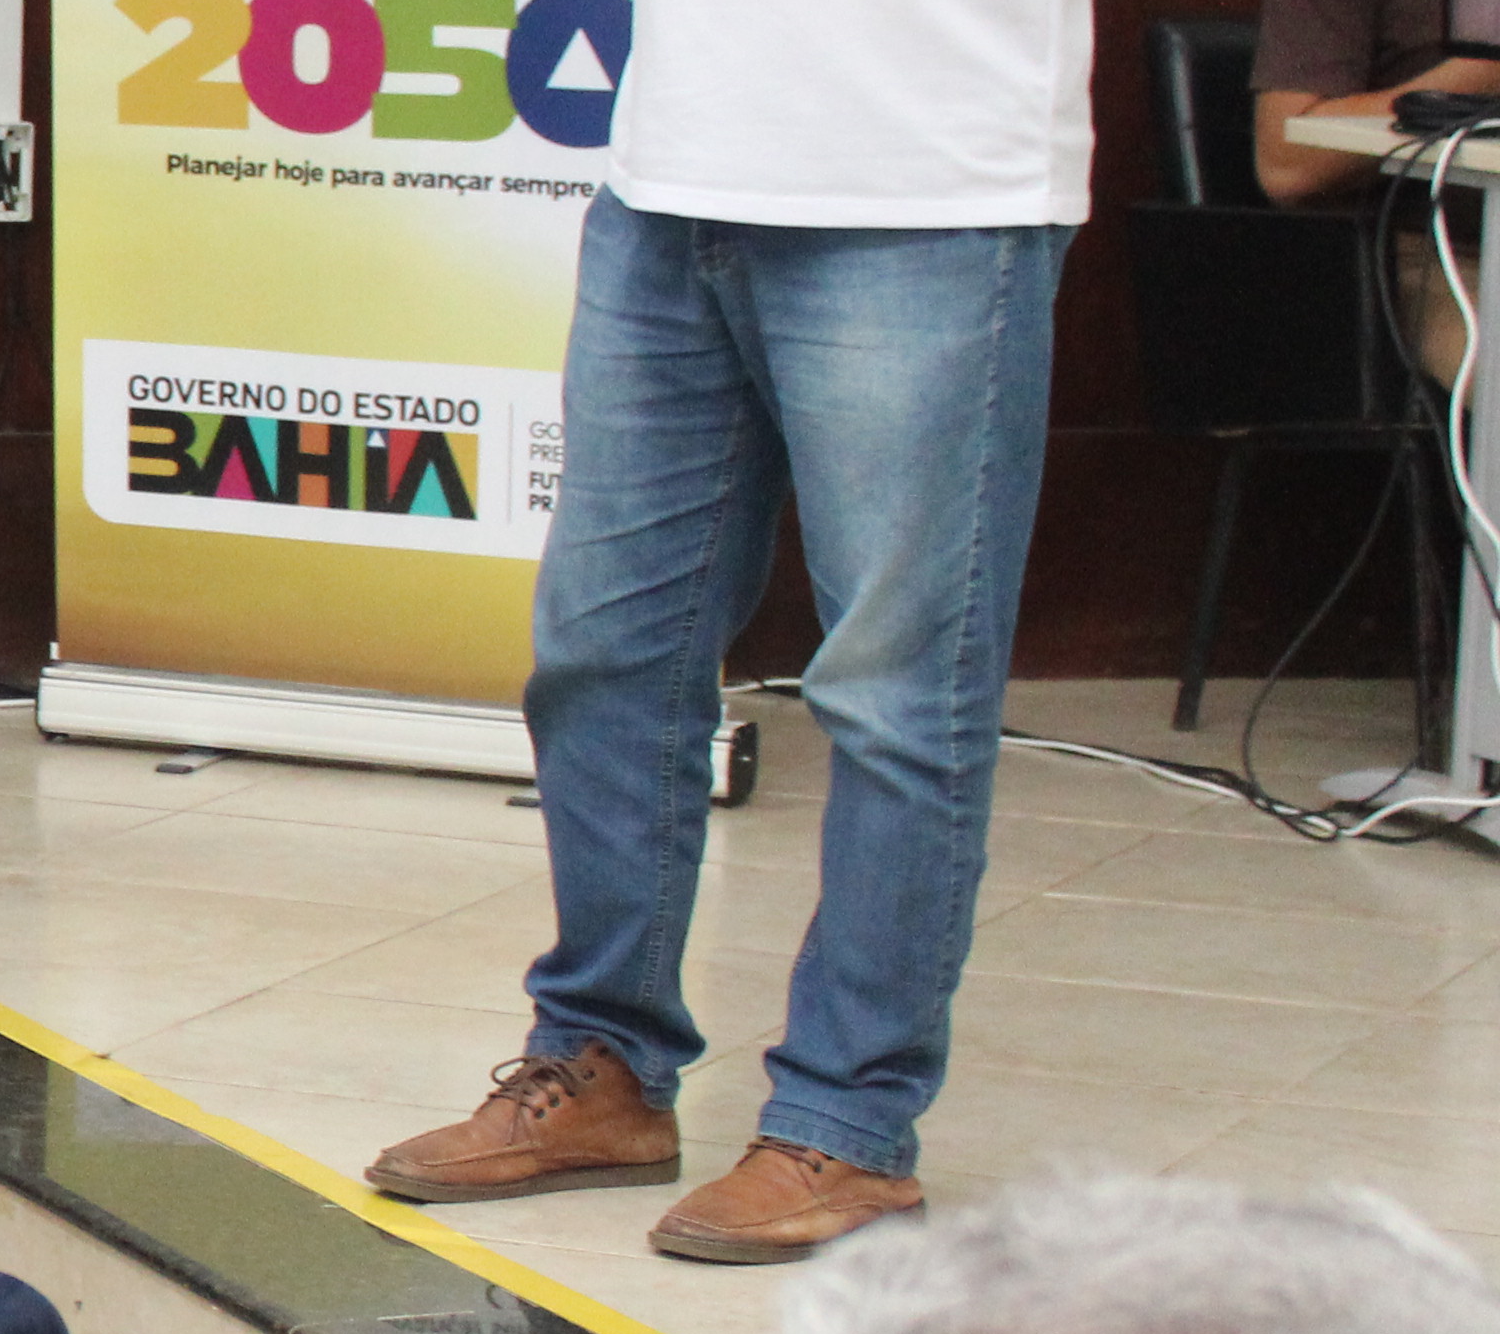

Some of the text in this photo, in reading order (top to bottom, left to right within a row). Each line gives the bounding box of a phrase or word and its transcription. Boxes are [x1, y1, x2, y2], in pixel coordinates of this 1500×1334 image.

[166, 153, 267, 181] Planejar
[274, 158, 323, 184] hoje
[332, 166, 384, 188] para
[393, 169, 492, 196] avançar
[128, 374, 479, 426] GOVERNO DO ESTADO
[128, 408, 478, 519] BAHIA
